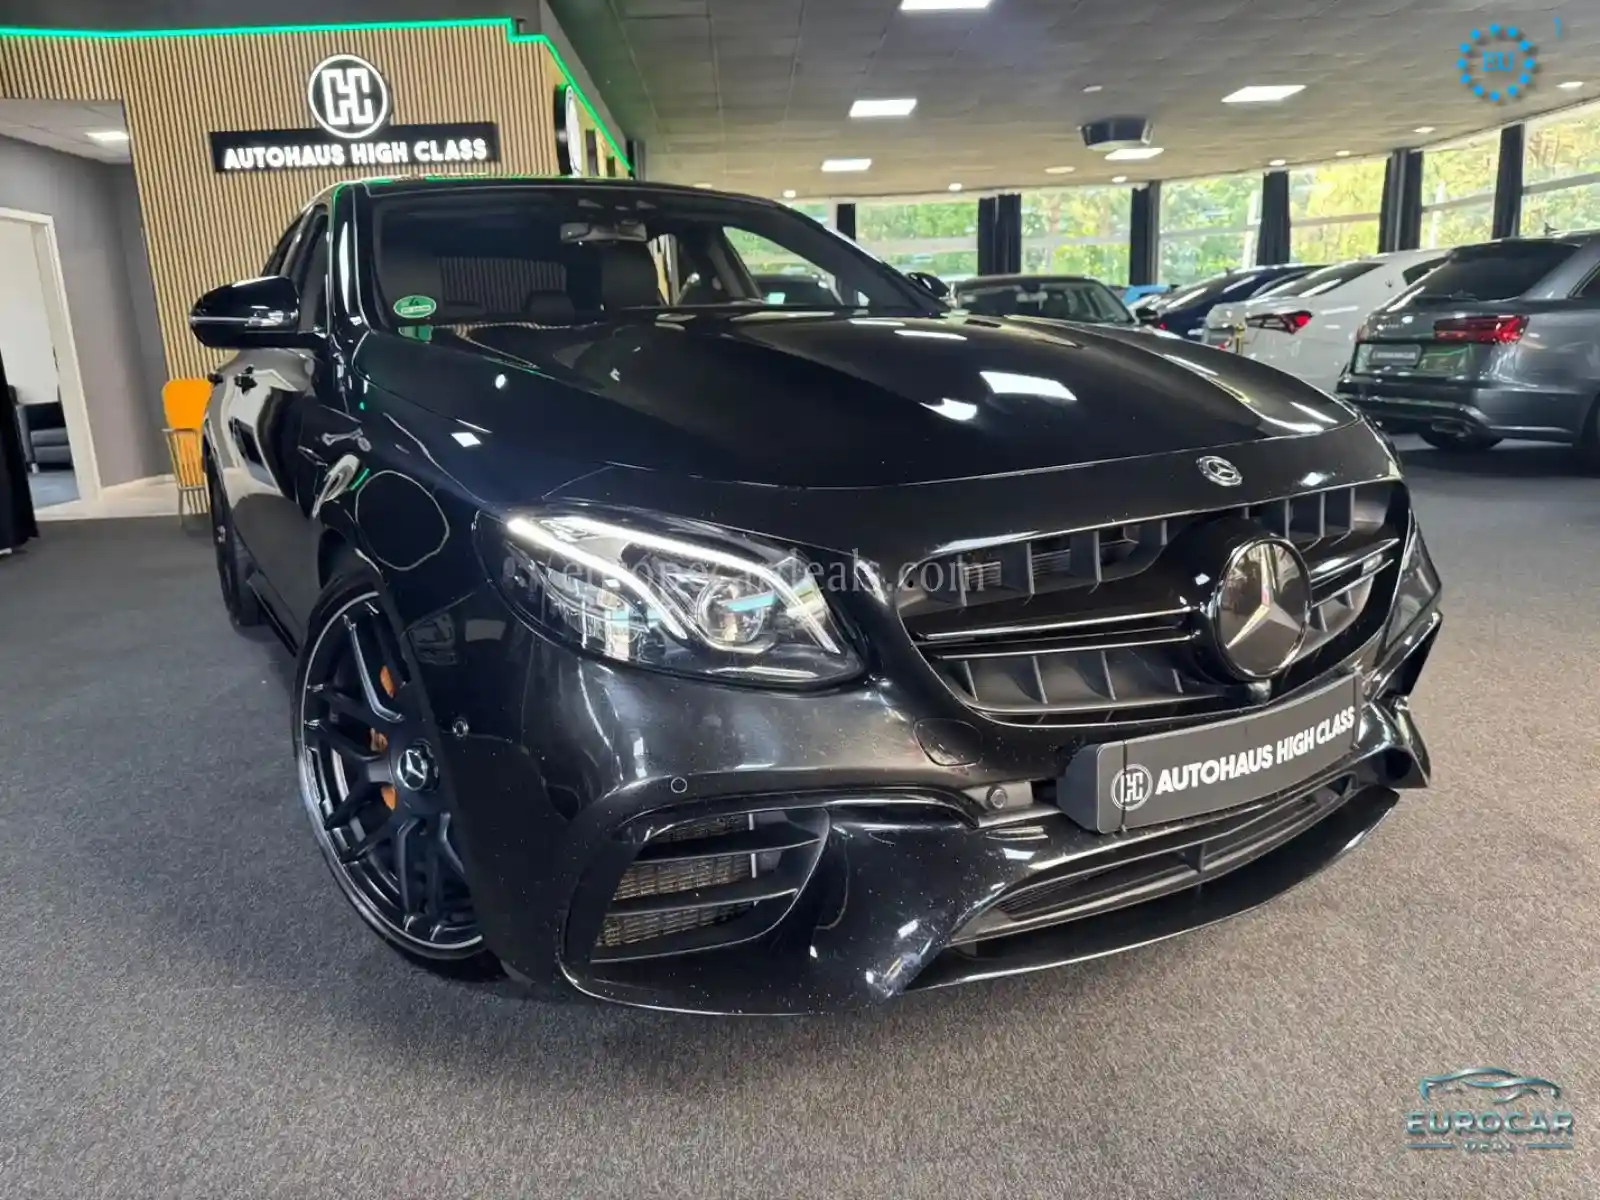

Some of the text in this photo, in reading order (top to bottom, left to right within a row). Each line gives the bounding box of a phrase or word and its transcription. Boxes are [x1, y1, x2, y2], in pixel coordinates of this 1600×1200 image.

[224, 138, 487, 169] AUTOHAUS HIGH CLASS
[1155, 705, 1355, 795] AUTOHAUS HIGH CLASS
